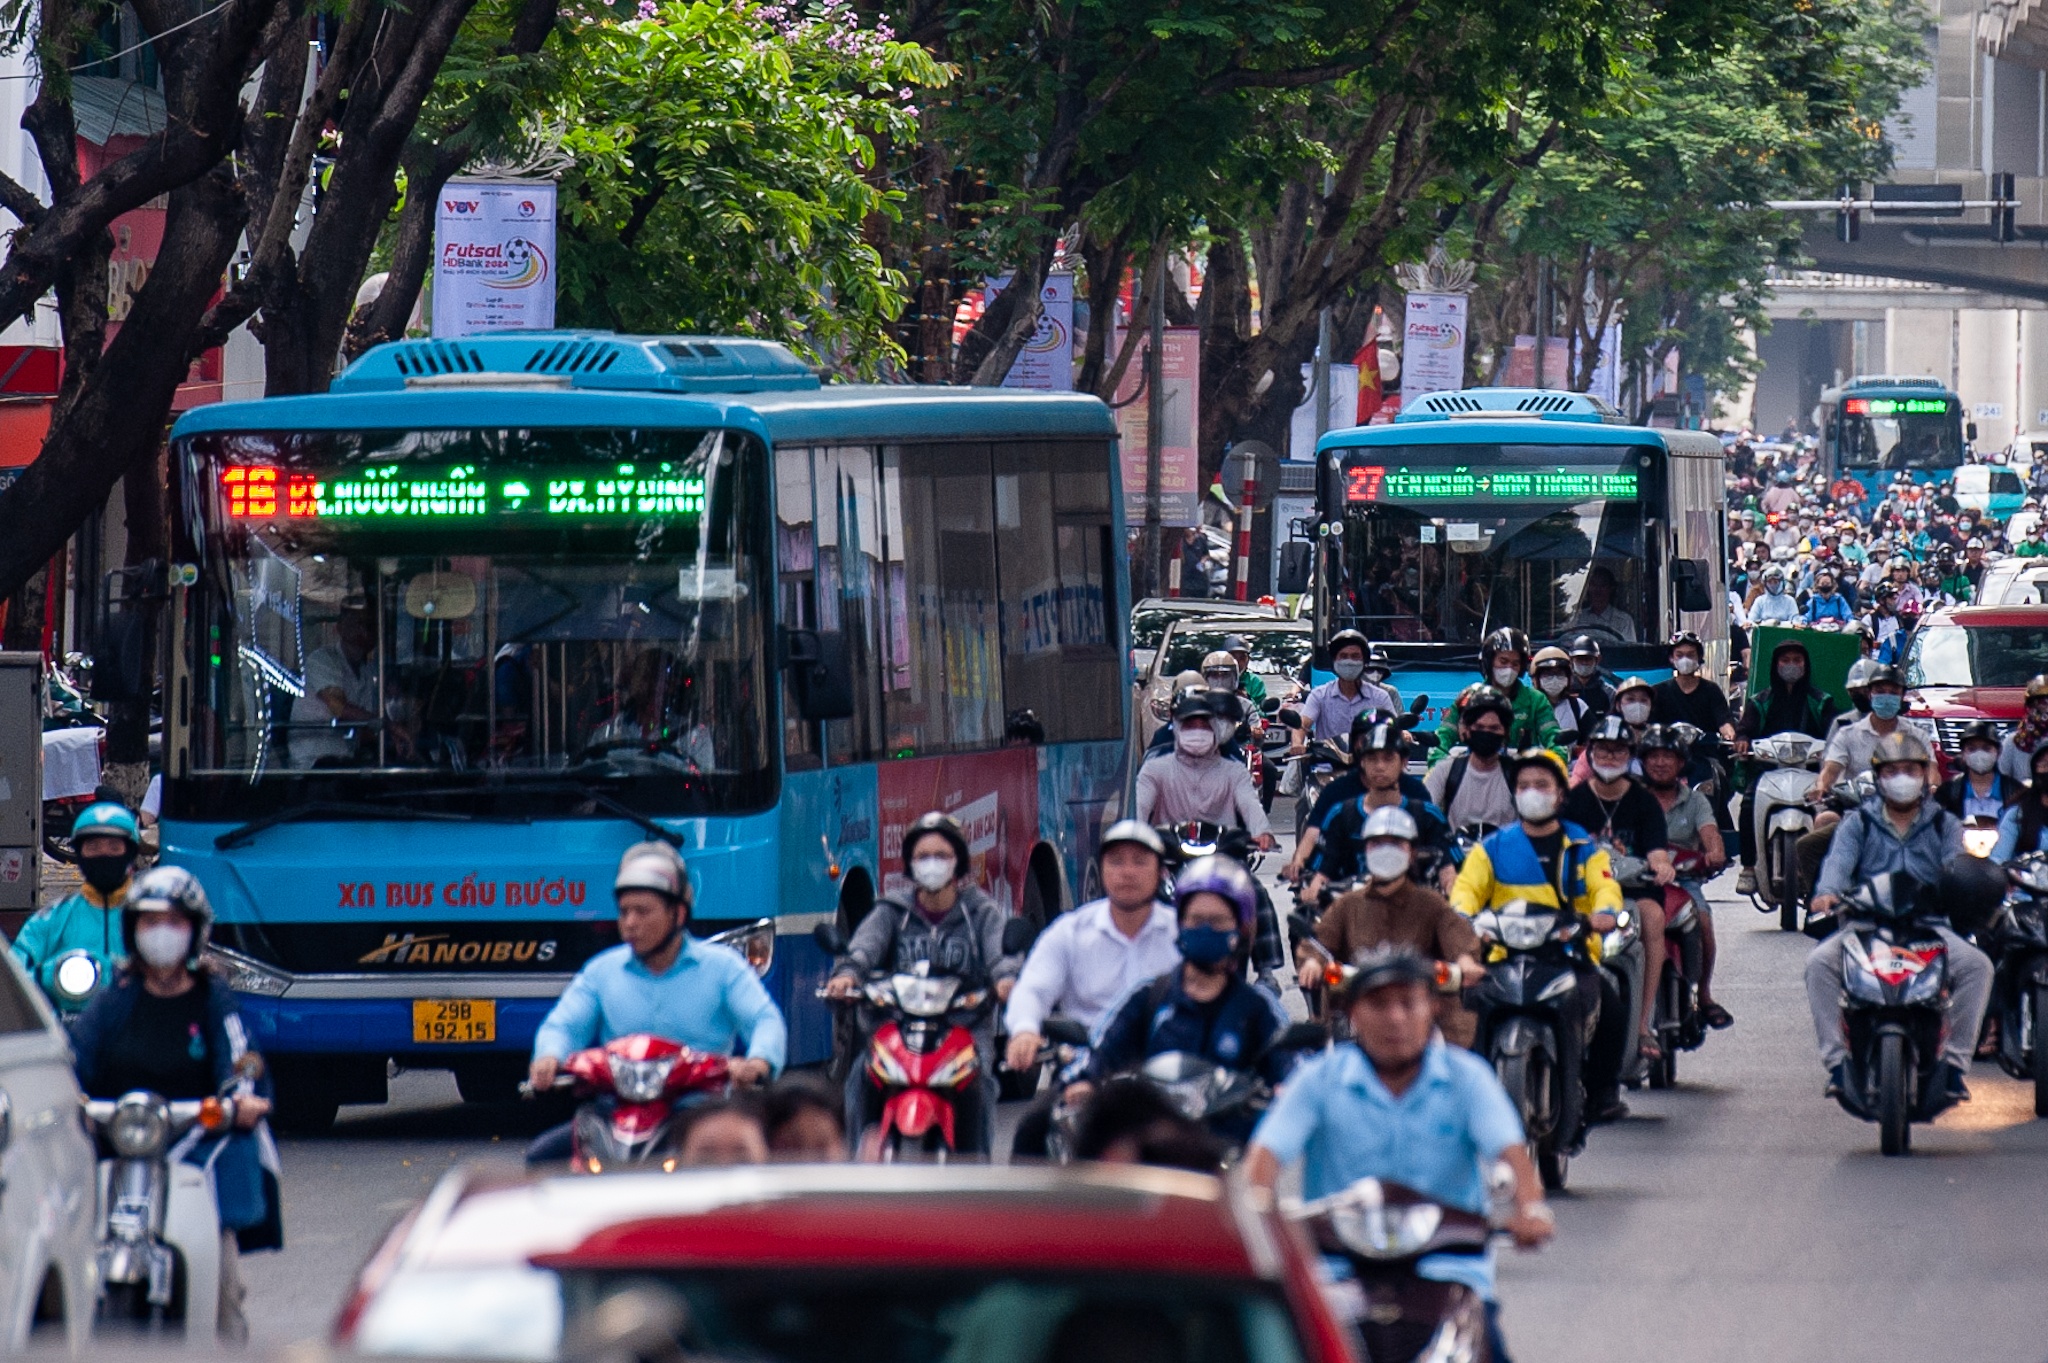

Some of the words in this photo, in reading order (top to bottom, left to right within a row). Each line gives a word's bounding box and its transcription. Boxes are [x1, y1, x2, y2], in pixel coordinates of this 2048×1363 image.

[444, 201, 480, 213] VOV
[444, 243, 502, 258] Futsal
[443, 259, 483, 268] HDBank
[485, 260, 508, 268] 2024
[1349, 466, 1384, 500] 27
[386, 882, 435, 908] BUS
[437, 1001, 471, 1019] 29B
[424, 1021, 487, 1040] 192.15
